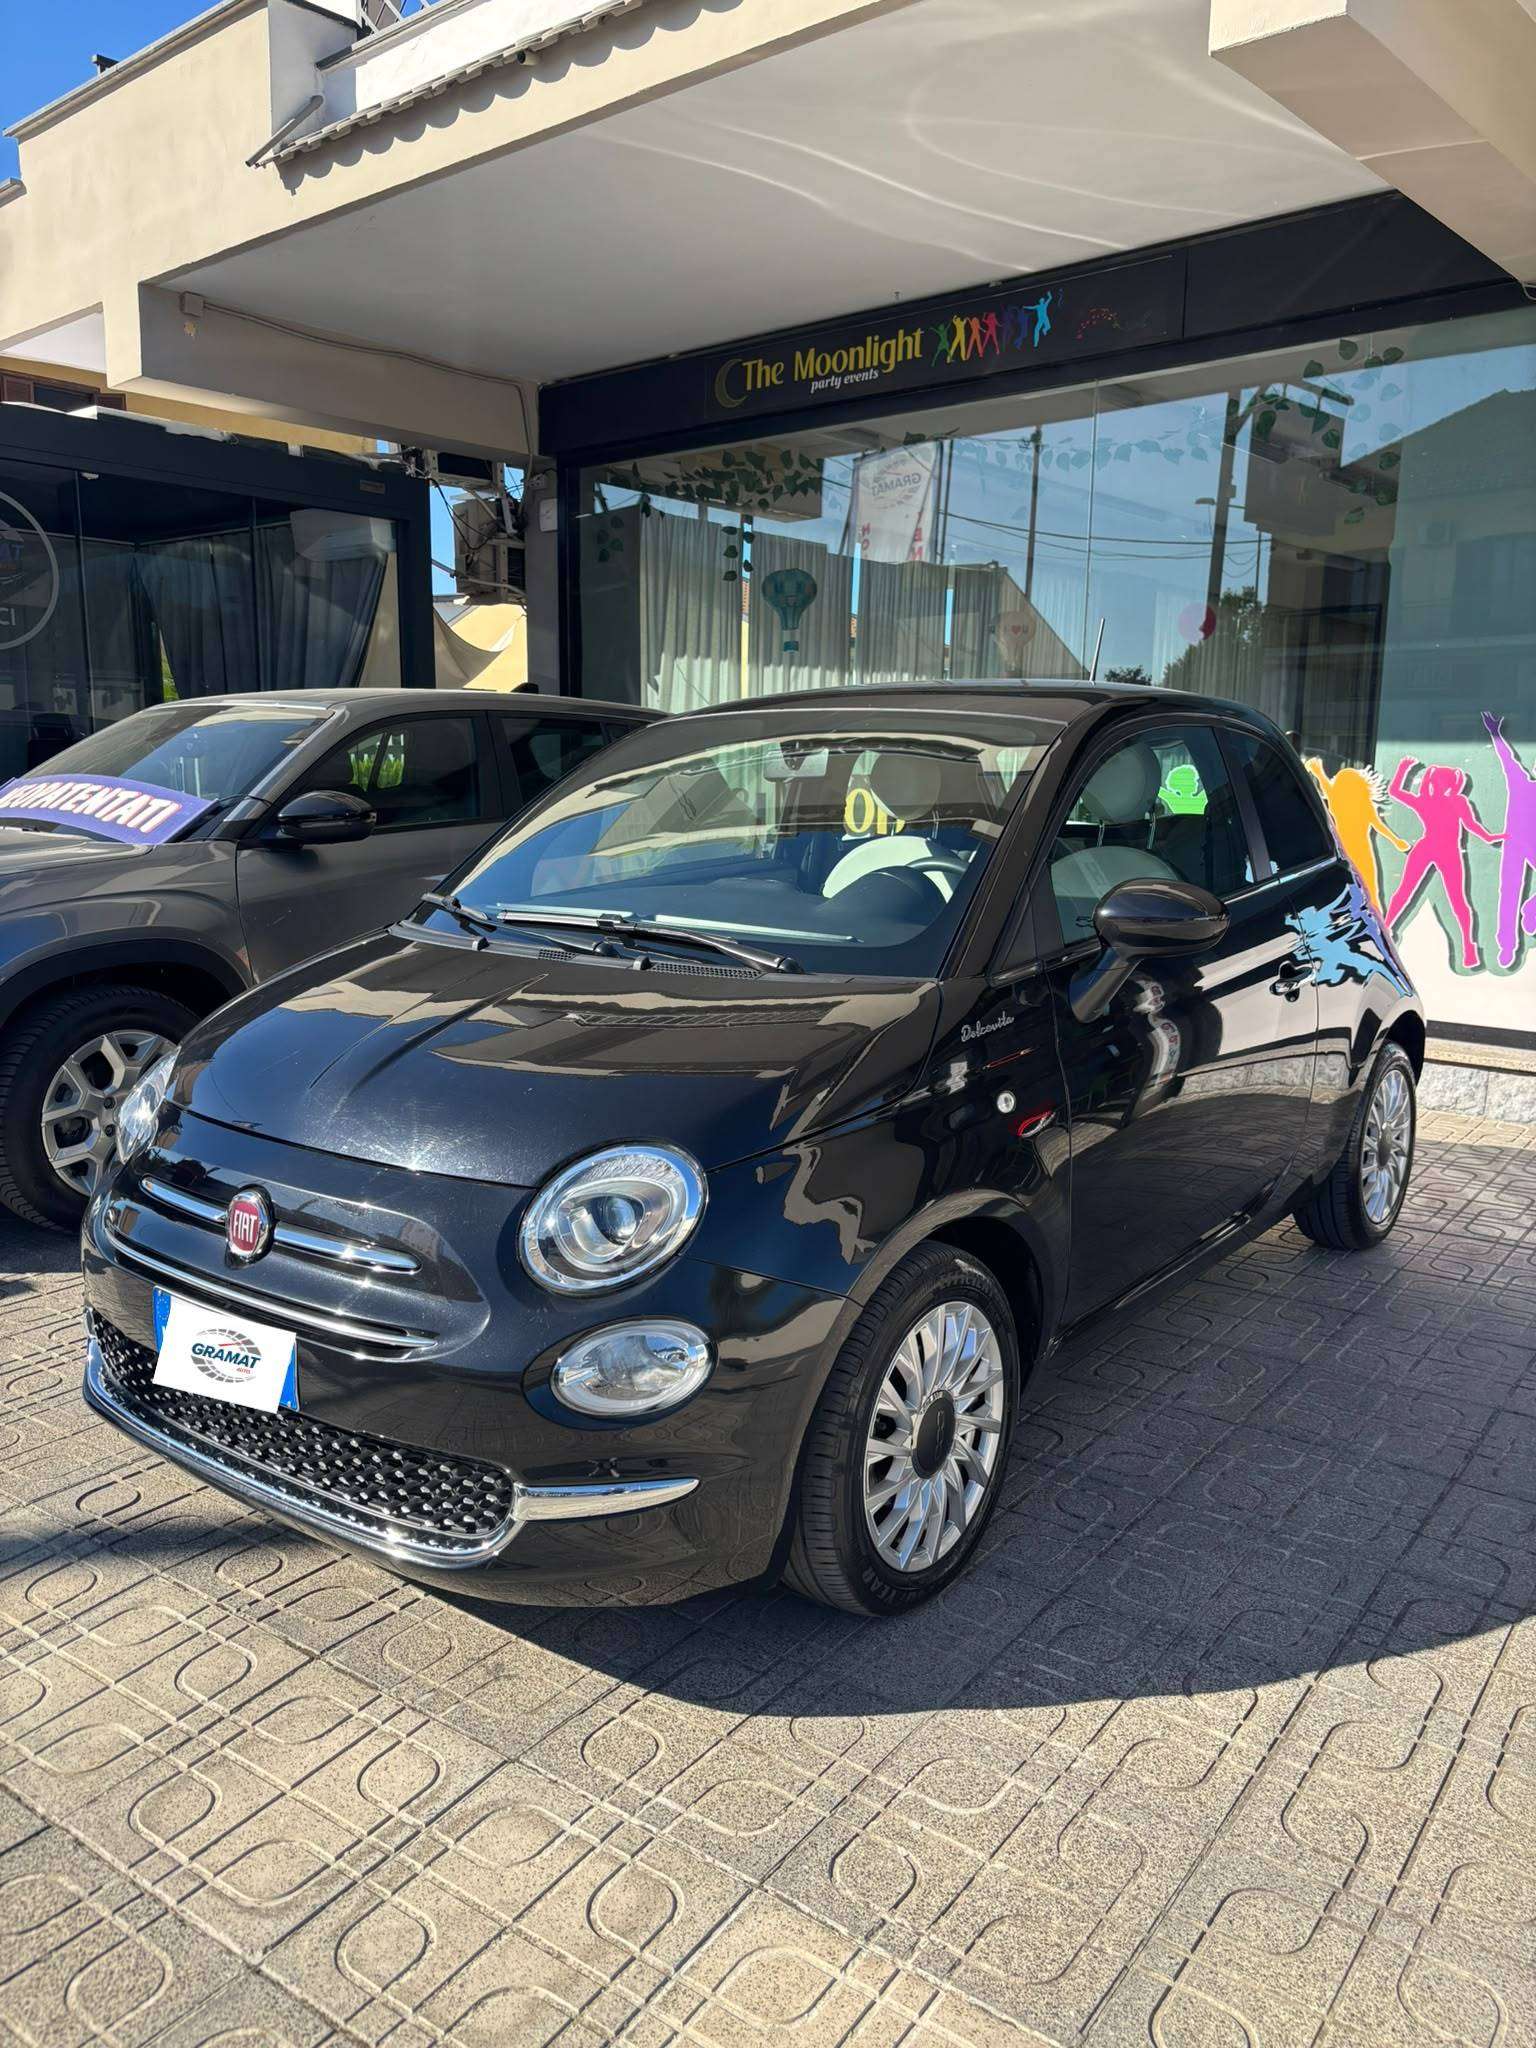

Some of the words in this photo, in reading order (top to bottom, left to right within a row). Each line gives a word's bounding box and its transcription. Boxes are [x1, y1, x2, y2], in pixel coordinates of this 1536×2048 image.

[742, 358, 784, 391] The
[794, 327, 924, 382] Moonlight
[810, 373, 842, 394] party
[844, 368, 879, 385] events
[233, 1209, 258, 1244] FIAT
[192, 1343, 262, 1369] GRAMAT
